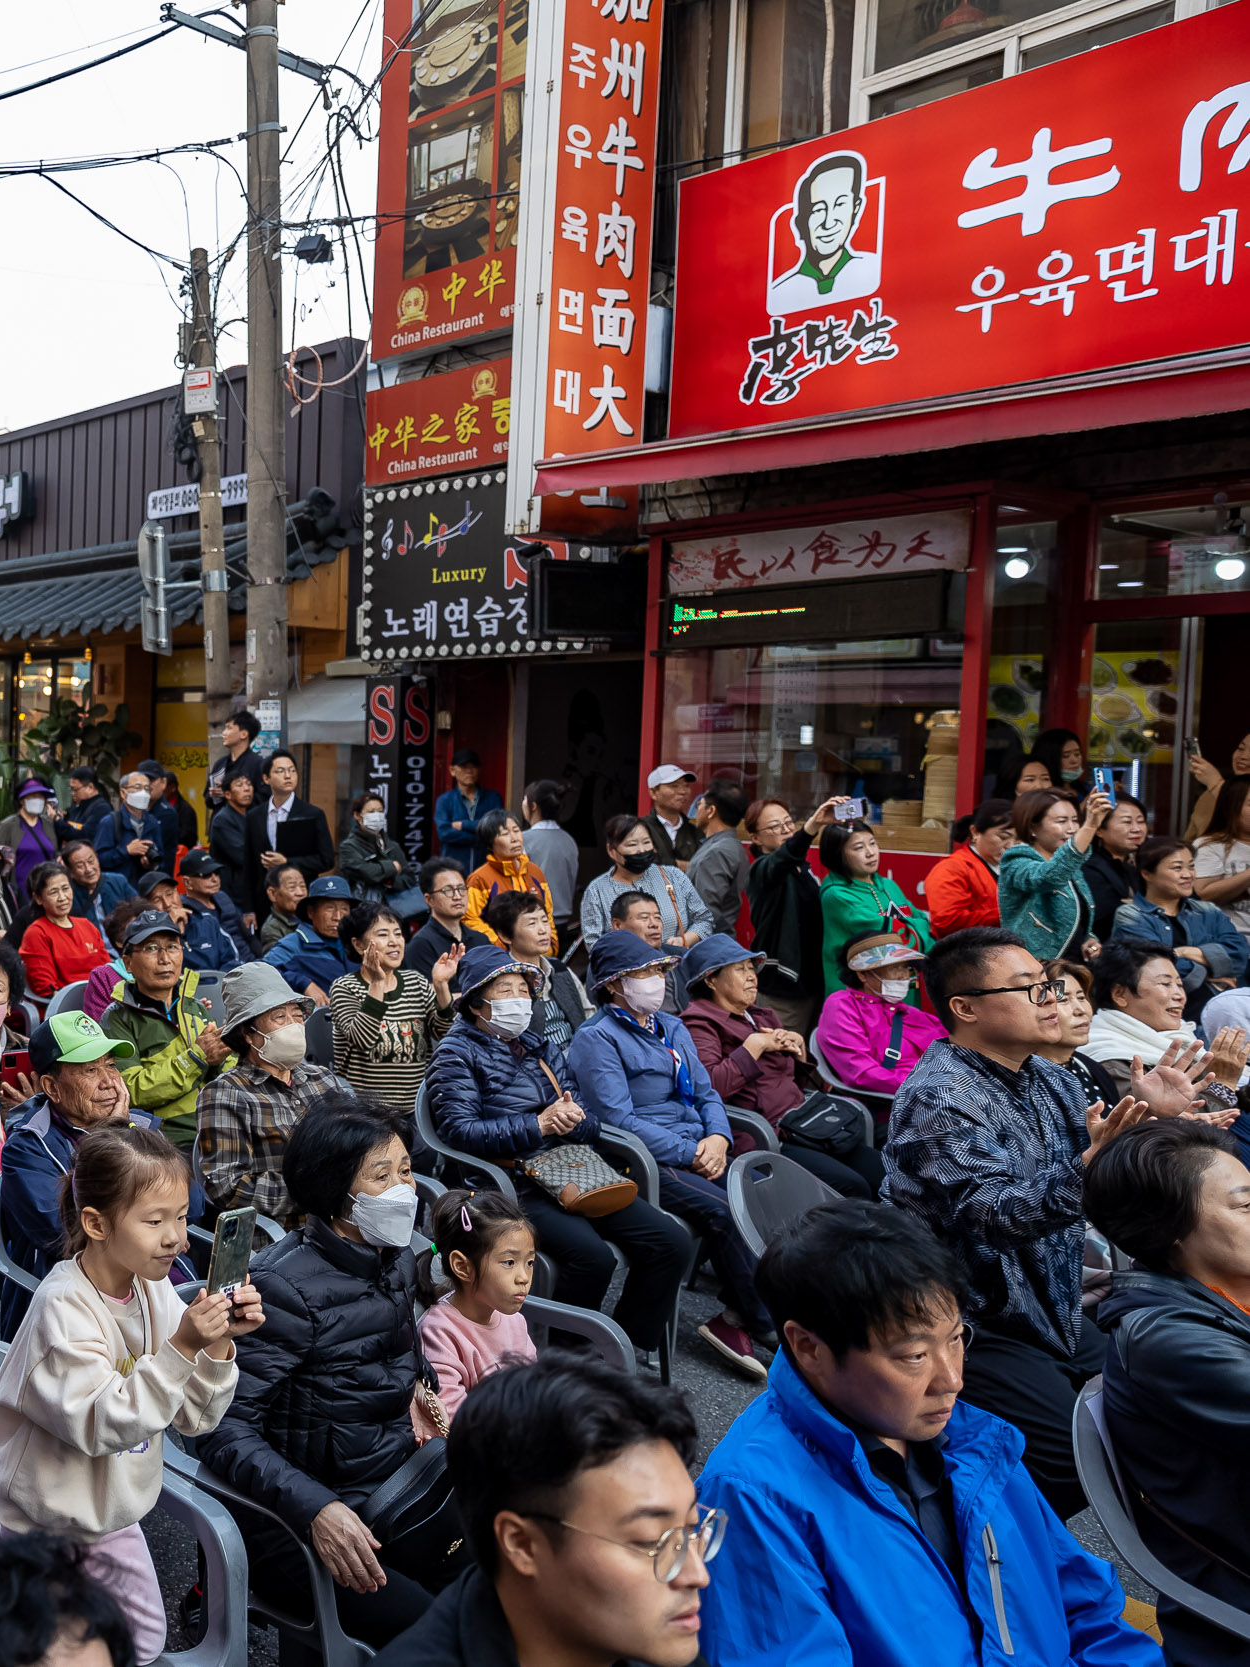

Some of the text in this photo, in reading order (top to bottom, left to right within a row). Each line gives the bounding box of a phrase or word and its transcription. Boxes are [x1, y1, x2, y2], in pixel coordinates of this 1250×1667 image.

[441, 259, 507, 316] 中华
[955, 208, 1250, 334] 우육면대
[390, 311, 484, 349] China Restaurant
[368, 402, 481, 461] 中华之家
[387, 446, 478, 475] China Restaurant
[221, 479, 248, 501] -999
[432, 567, 486, 584] Luxury
[369, 685, 395, 746] S
[404, 687, 430, 746] S
